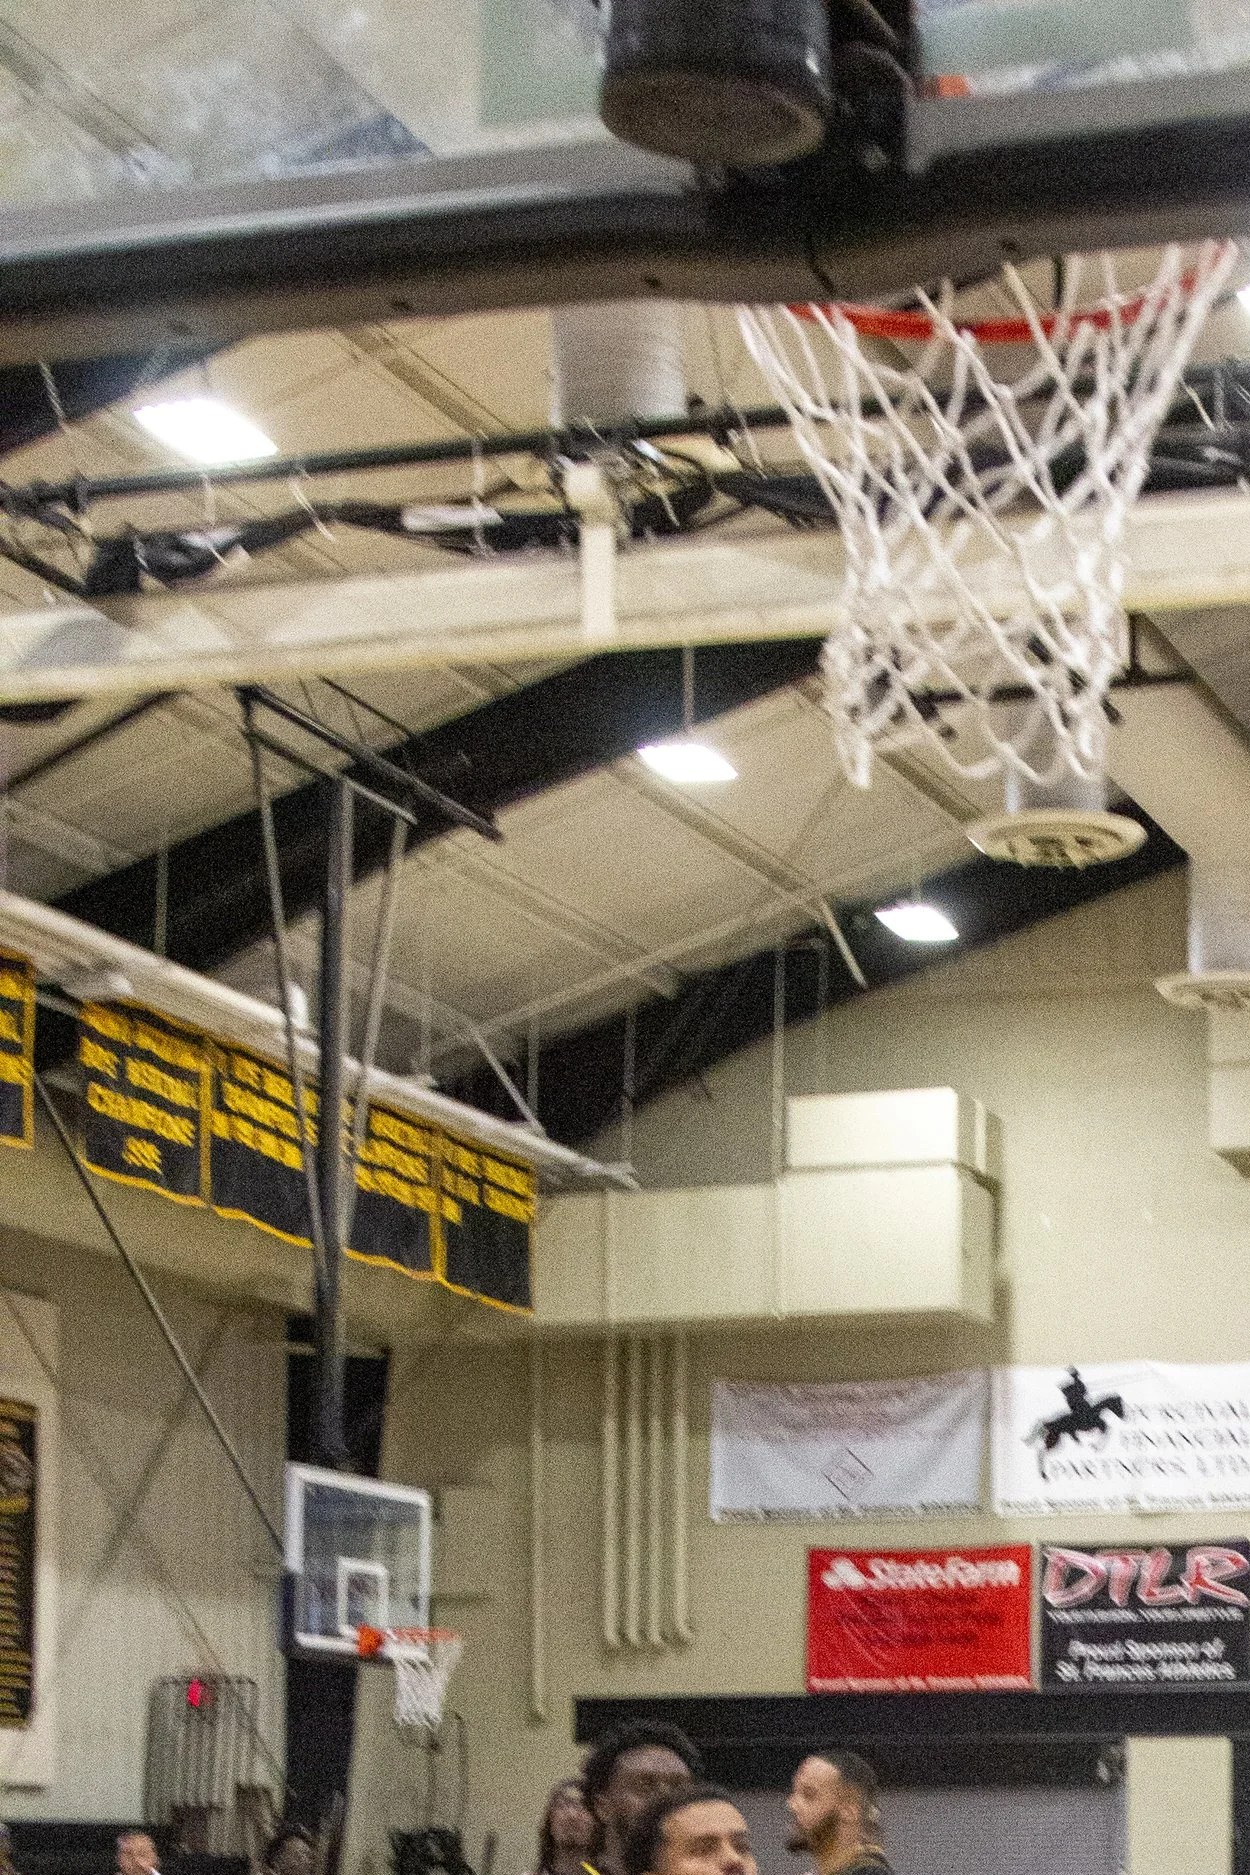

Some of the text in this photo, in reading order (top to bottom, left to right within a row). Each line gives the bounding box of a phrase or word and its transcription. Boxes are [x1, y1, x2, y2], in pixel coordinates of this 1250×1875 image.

[1047, 1457, 1189, 1481] PARTNERS
[1042, 1547, 1250, 1608] DTLR
[1067, 1636, 1227, 1662] Proud Sponsor of
[1155, 1660, 1237, 1682] Athletics
